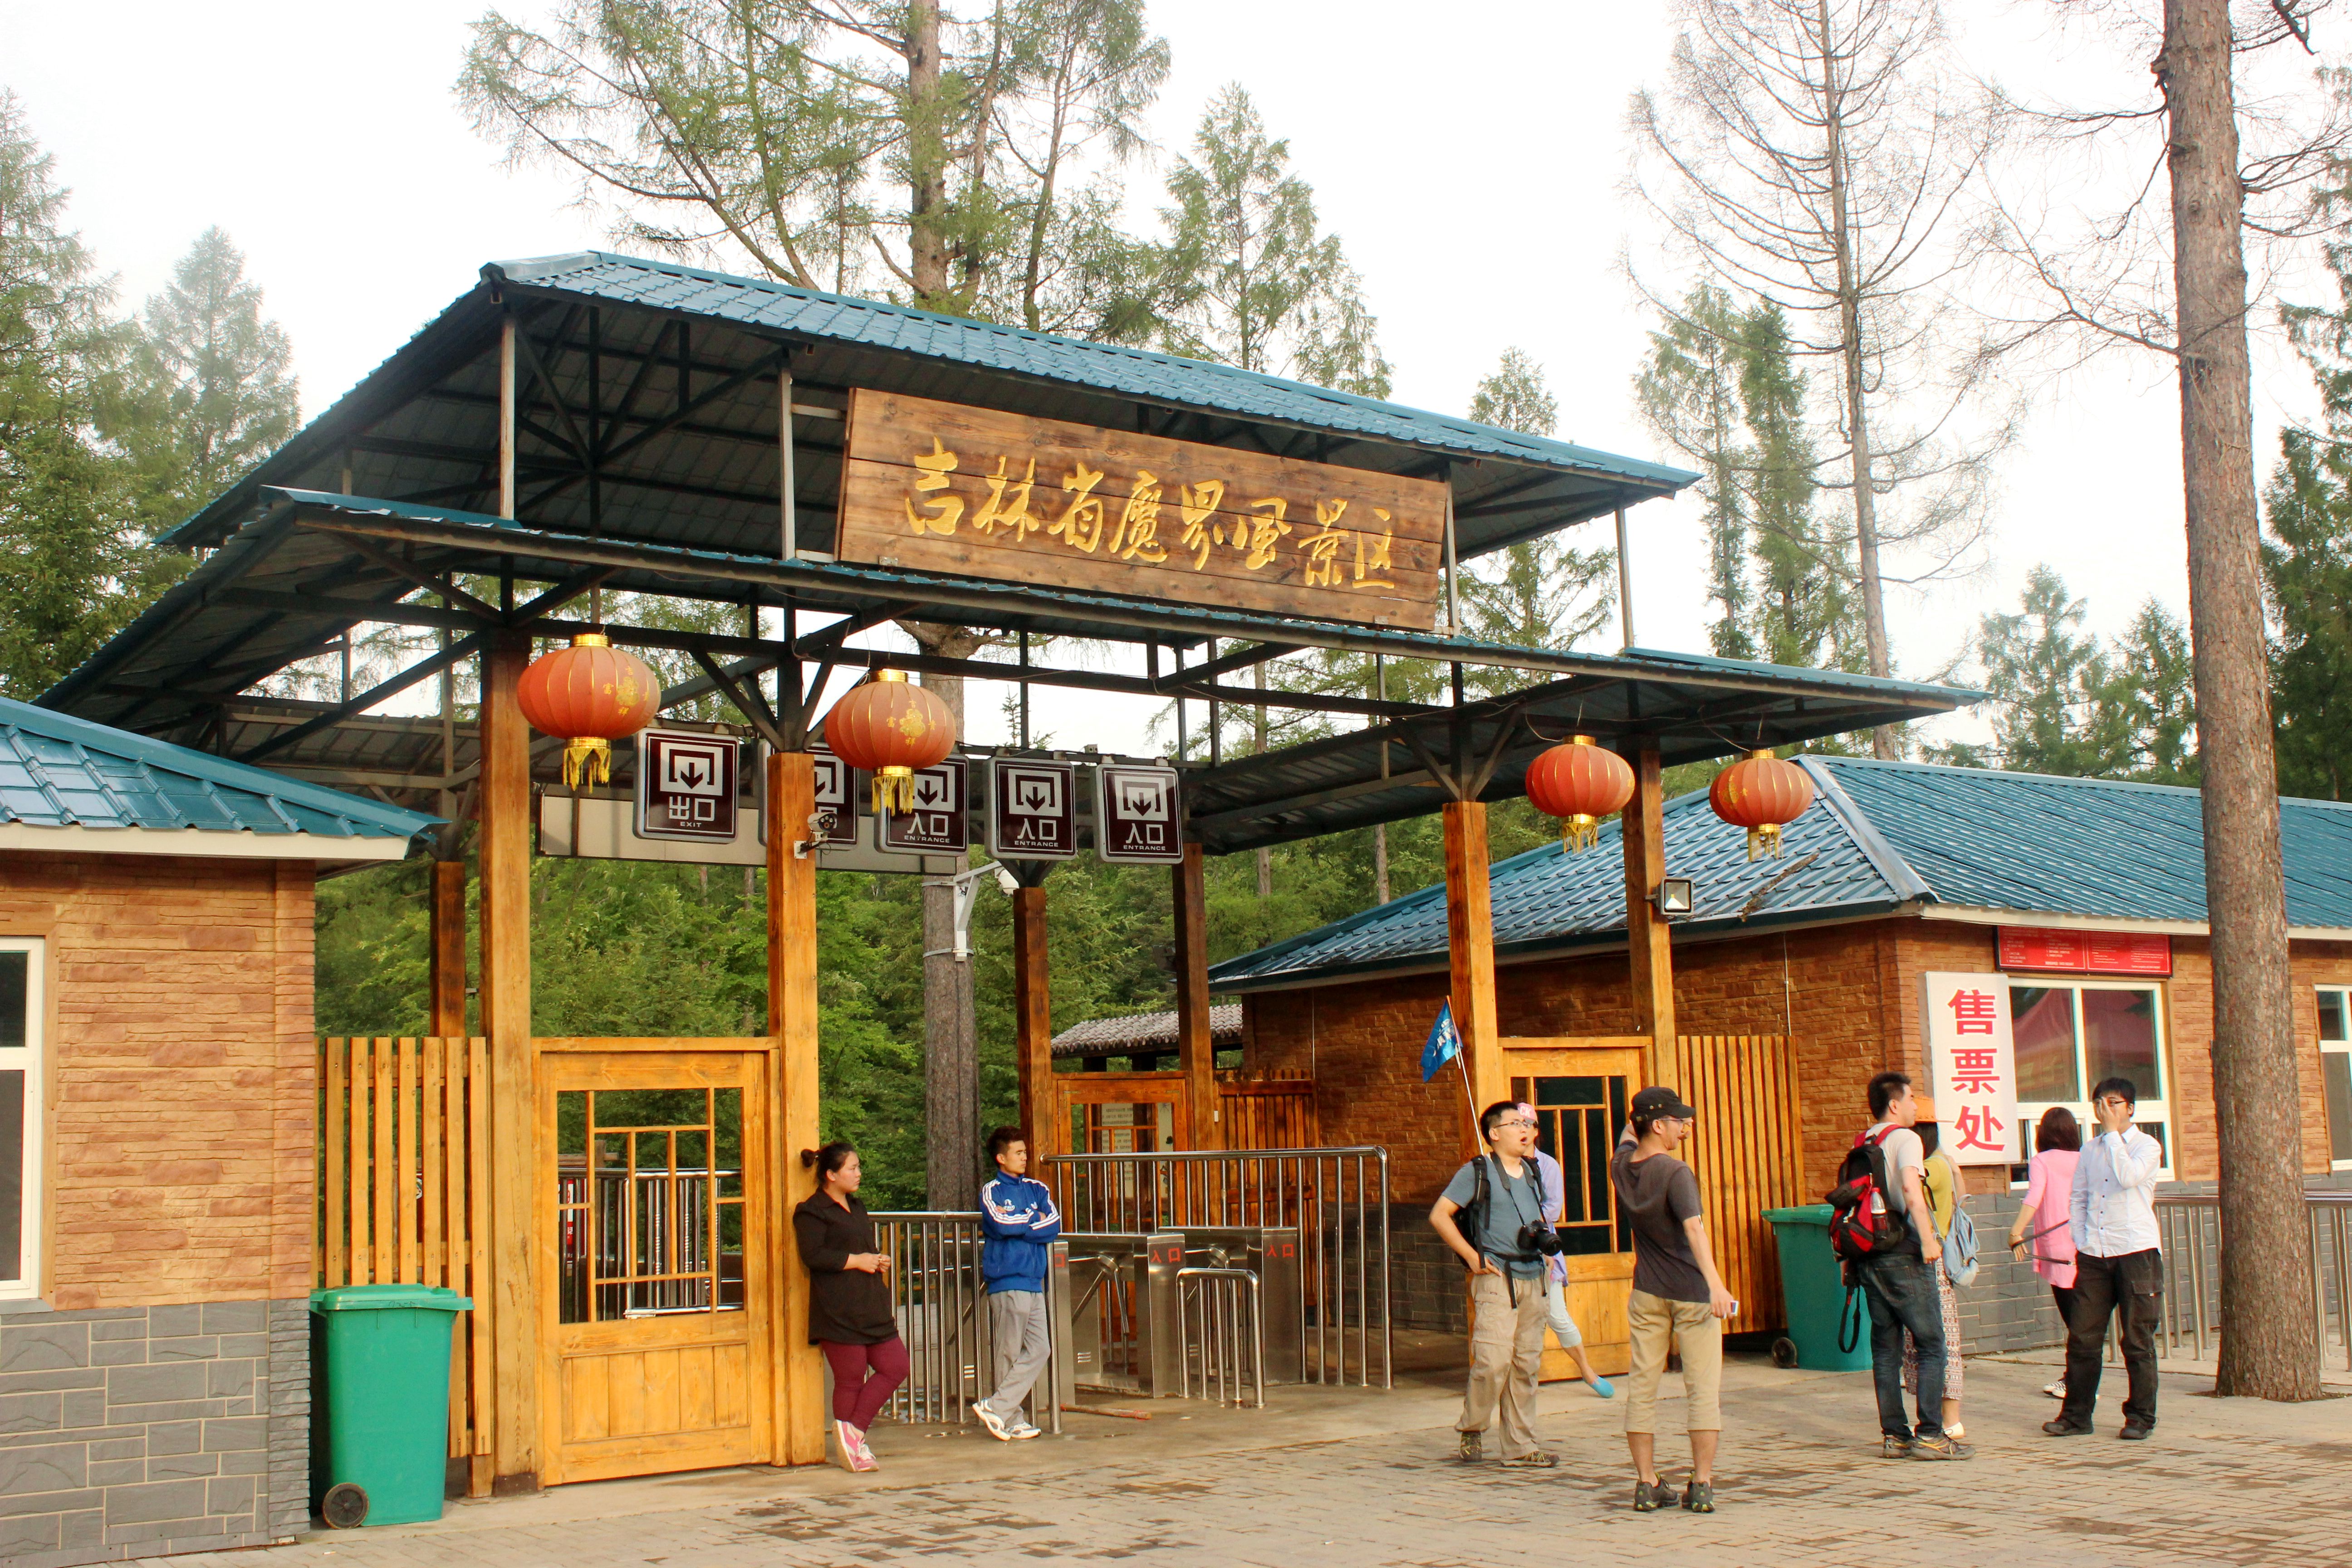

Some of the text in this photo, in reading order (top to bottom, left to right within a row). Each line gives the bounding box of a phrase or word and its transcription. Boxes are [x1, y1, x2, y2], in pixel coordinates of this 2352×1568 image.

[669, 796, 715, 821] 出口
[907, 813, 949, 836] 入口
[1017, 818, 1057, 840] 入口
[1126, 823, 1164, 844] 入口
[1948, 989, 2005, 1152] 售票处
[1150, 1247, 1181, 1264] 入口
[1266, 1243, 1294, 1258] 入口
